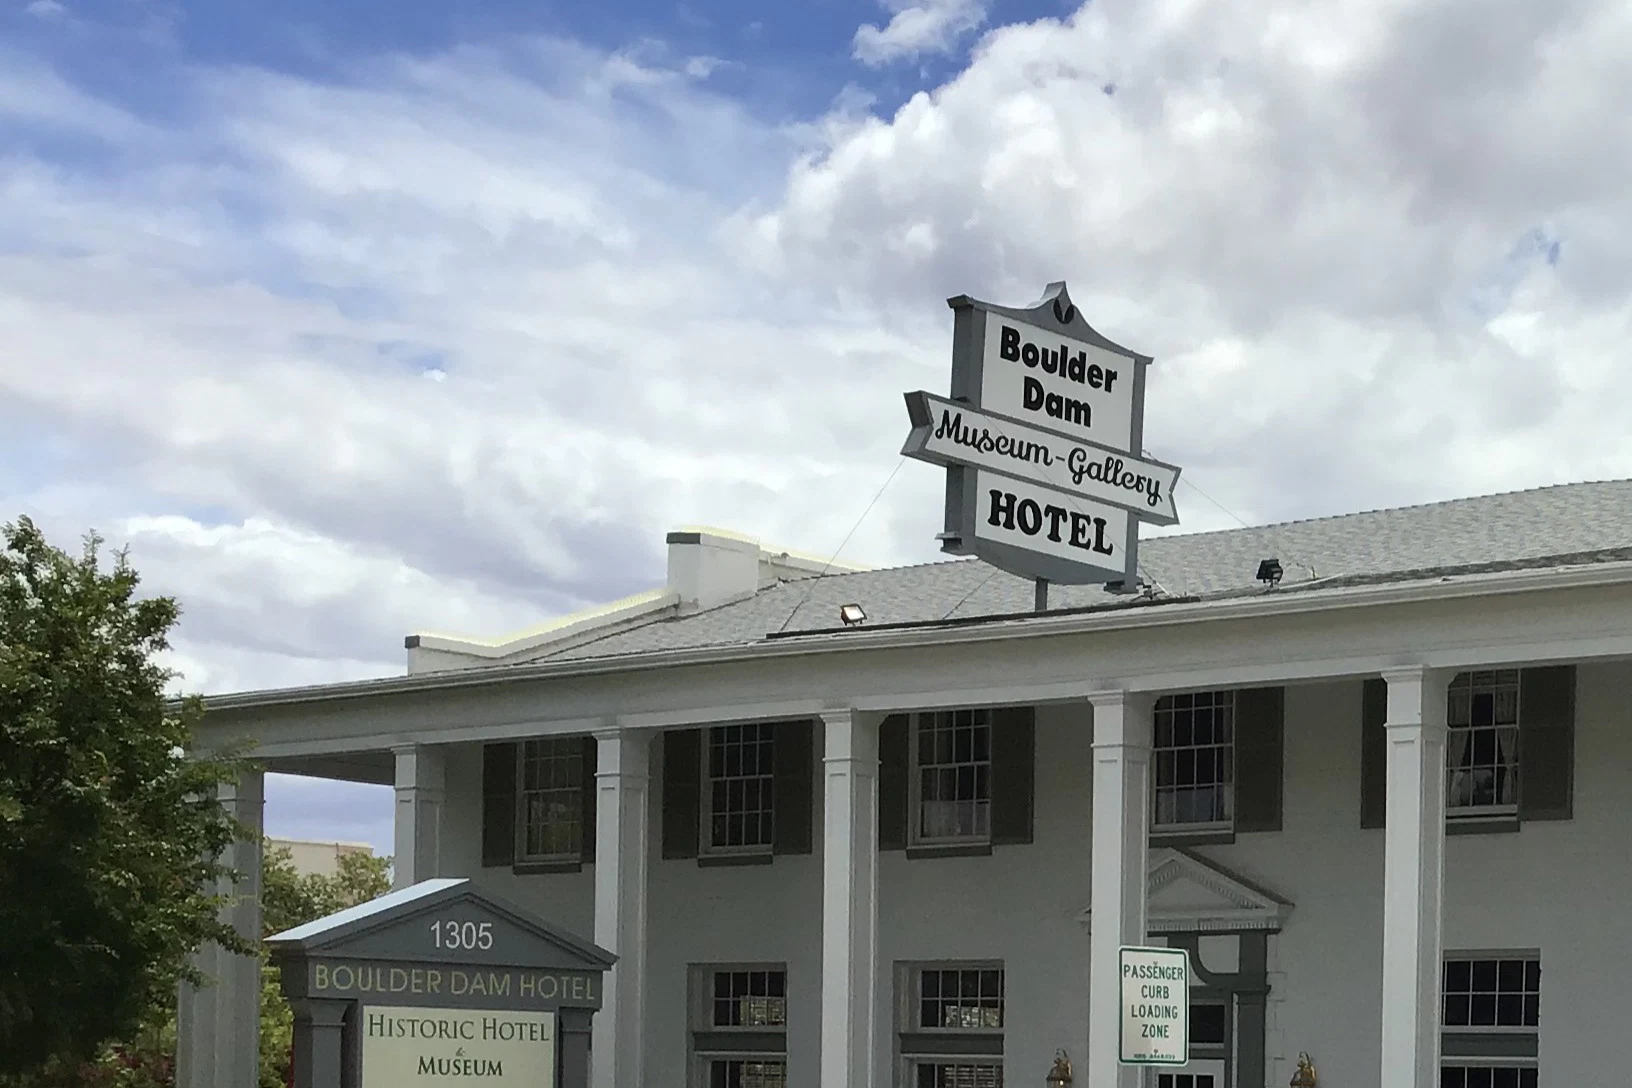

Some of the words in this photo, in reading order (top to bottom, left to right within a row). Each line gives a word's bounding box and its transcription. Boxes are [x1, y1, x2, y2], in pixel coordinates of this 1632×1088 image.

[1000, 325, 1118, 393] Boulder
[1023, 376, 1092, 428] Dam
[987, 489, 1114, 556] HOTEL
[430, 919, 493, 950] 1305
[315, 964, 441, 994] BOULDER
[450, 971, 511, 997] DAM
[520, 975, 595, 1000] HOTEL
[1123, 964, 1184, 980] PASSENGER
[1141, 984, 1170, 999] CURB
[1131, 1004, 1178, 1020] LOADING
[368, 1013, 475, 1040] HISTORIC
[482, 1017, 549, 1041] HOTEL
[1141, 1024, 1170, 1039] ZONE
[455, 1046, 466, 1057] &
[417, 1056, 503, 1077] MUSEUM
